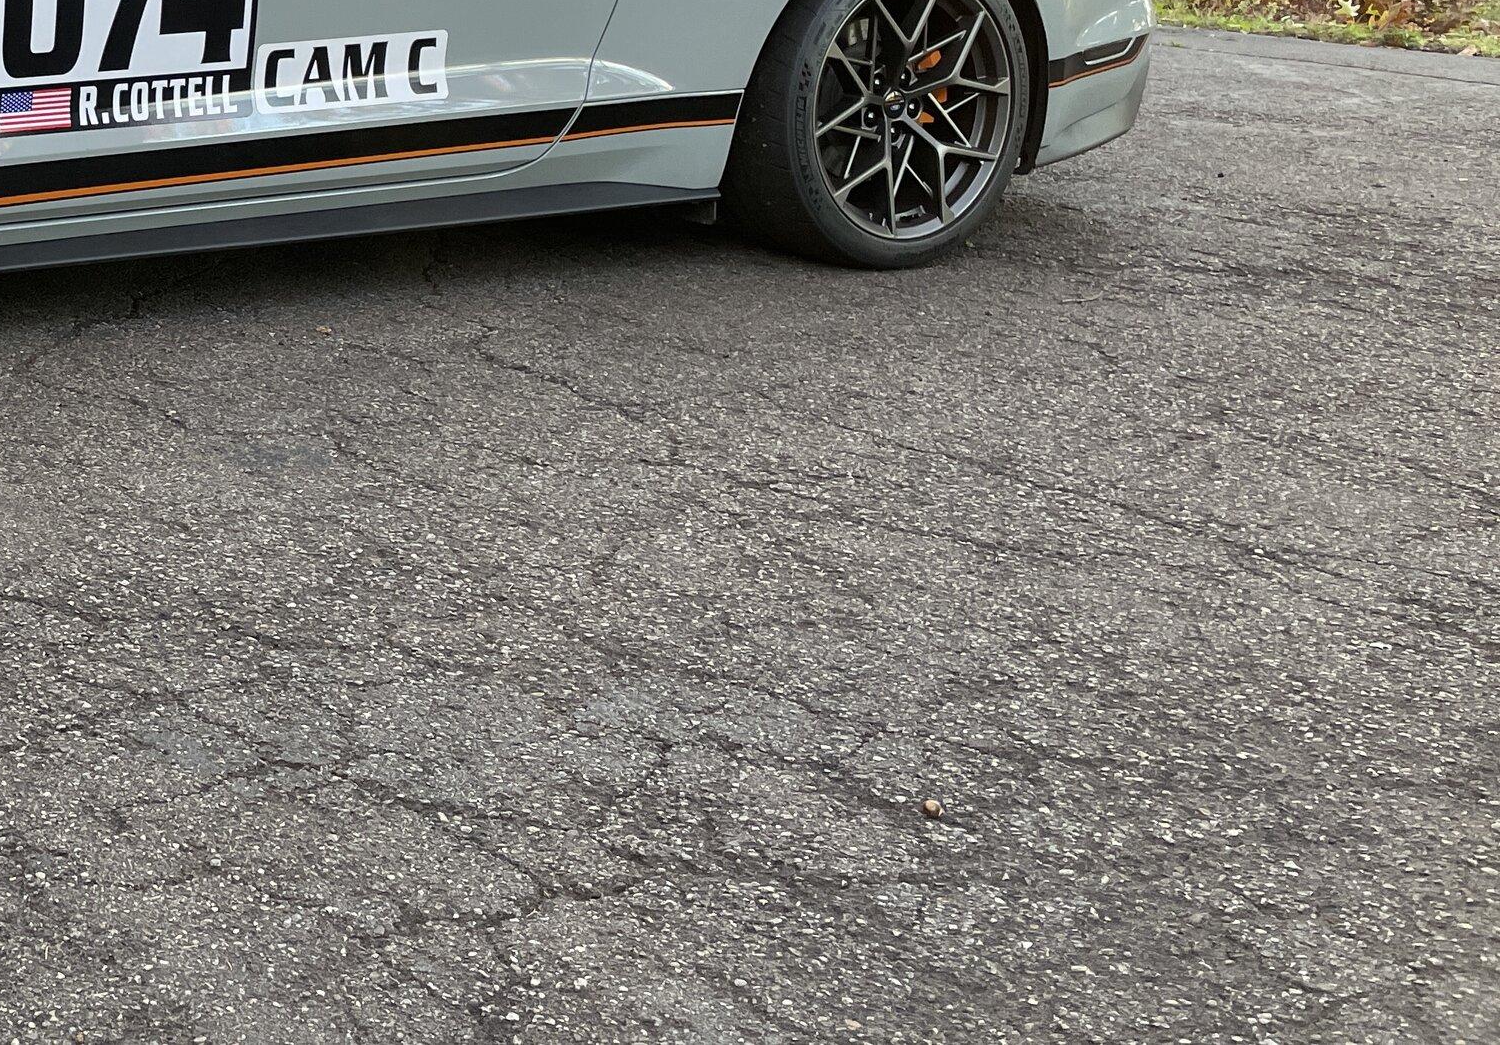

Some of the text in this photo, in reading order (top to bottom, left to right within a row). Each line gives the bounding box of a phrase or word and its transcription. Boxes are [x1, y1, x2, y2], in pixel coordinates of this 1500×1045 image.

[79, 74, 238, 126] R.COTTELL
[264, 37, 438, 108] CAM C
